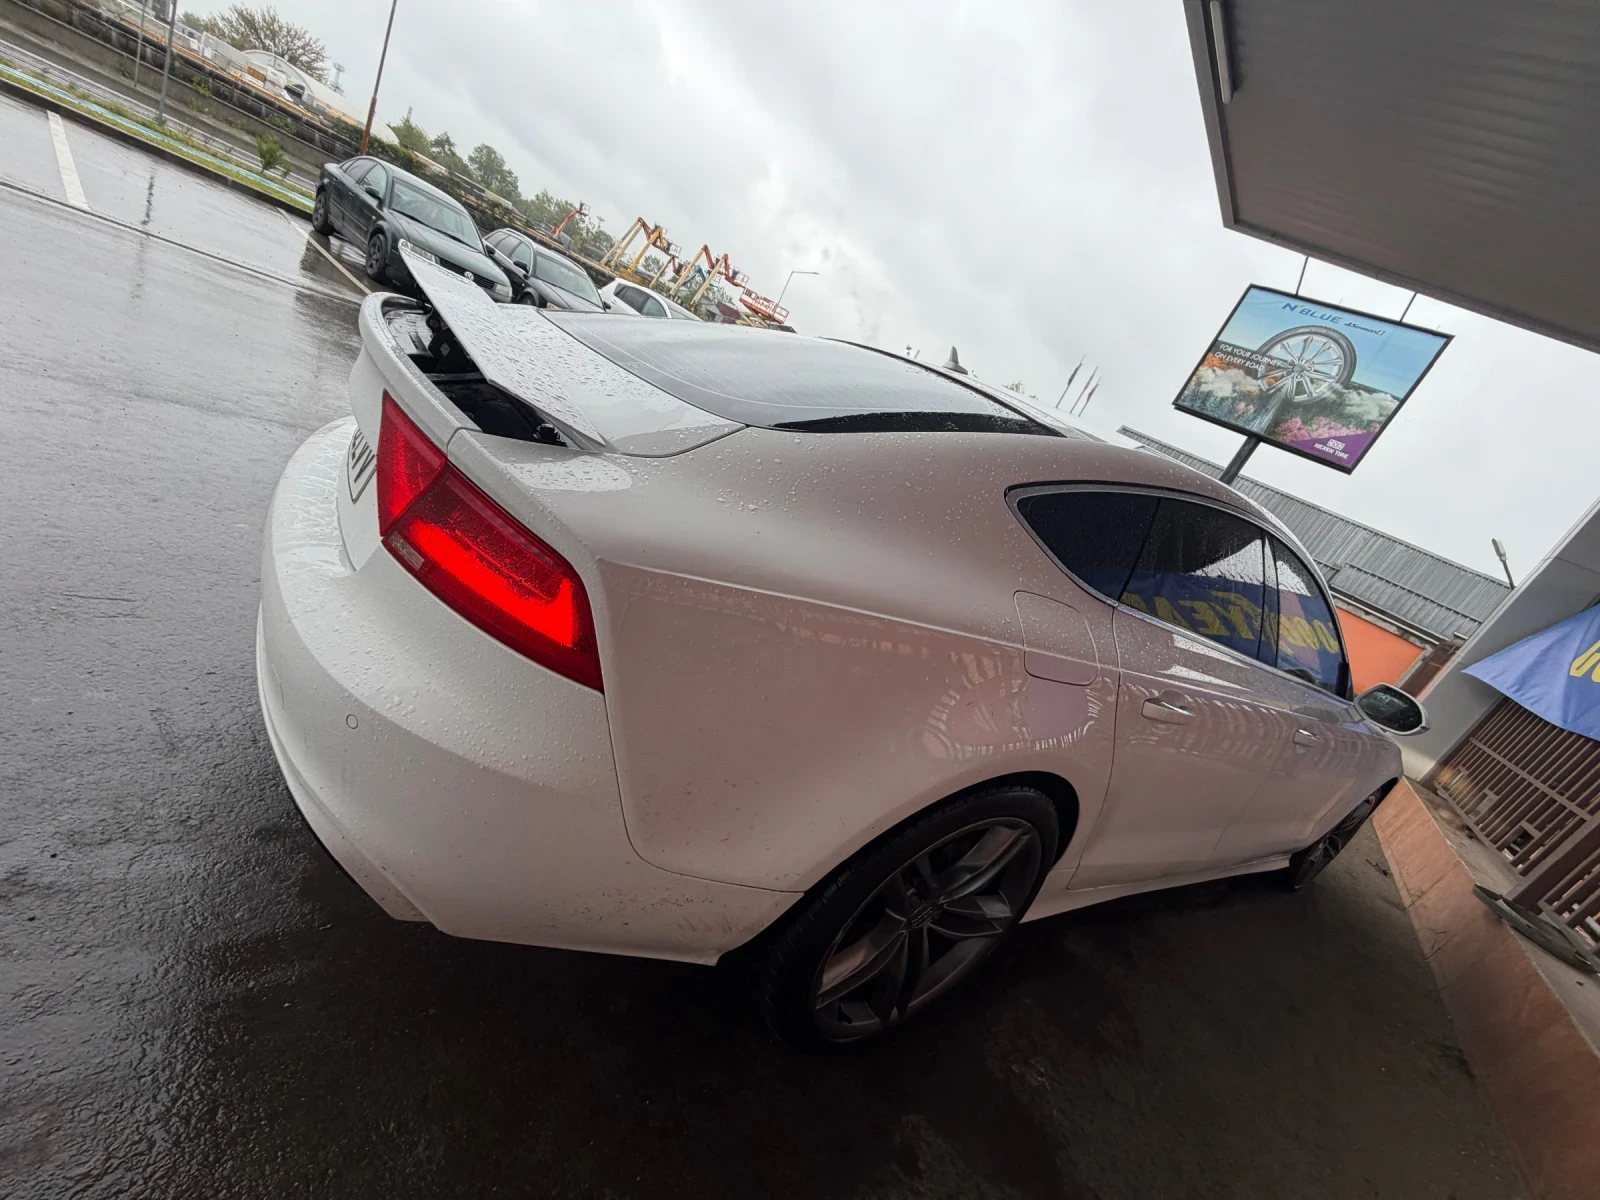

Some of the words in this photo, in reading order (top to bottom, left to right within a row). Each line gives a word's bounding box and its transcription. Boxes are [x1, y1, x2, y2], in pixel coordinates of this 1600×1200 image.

[1214, 351, 1226, 360] ON
[1227, 354, 1246, 366] EVERY
[1244, 360, 1265, 371] ROAD
[1219, 343, 1233, 353] FOR
[1233, 347, 1252, 359] YOUR
[1250, 352, 1282, 367] JOURNEY
[1313, 442, 1335, 454] NEXEN
[1334, 449, 1350, 460] TIRE
